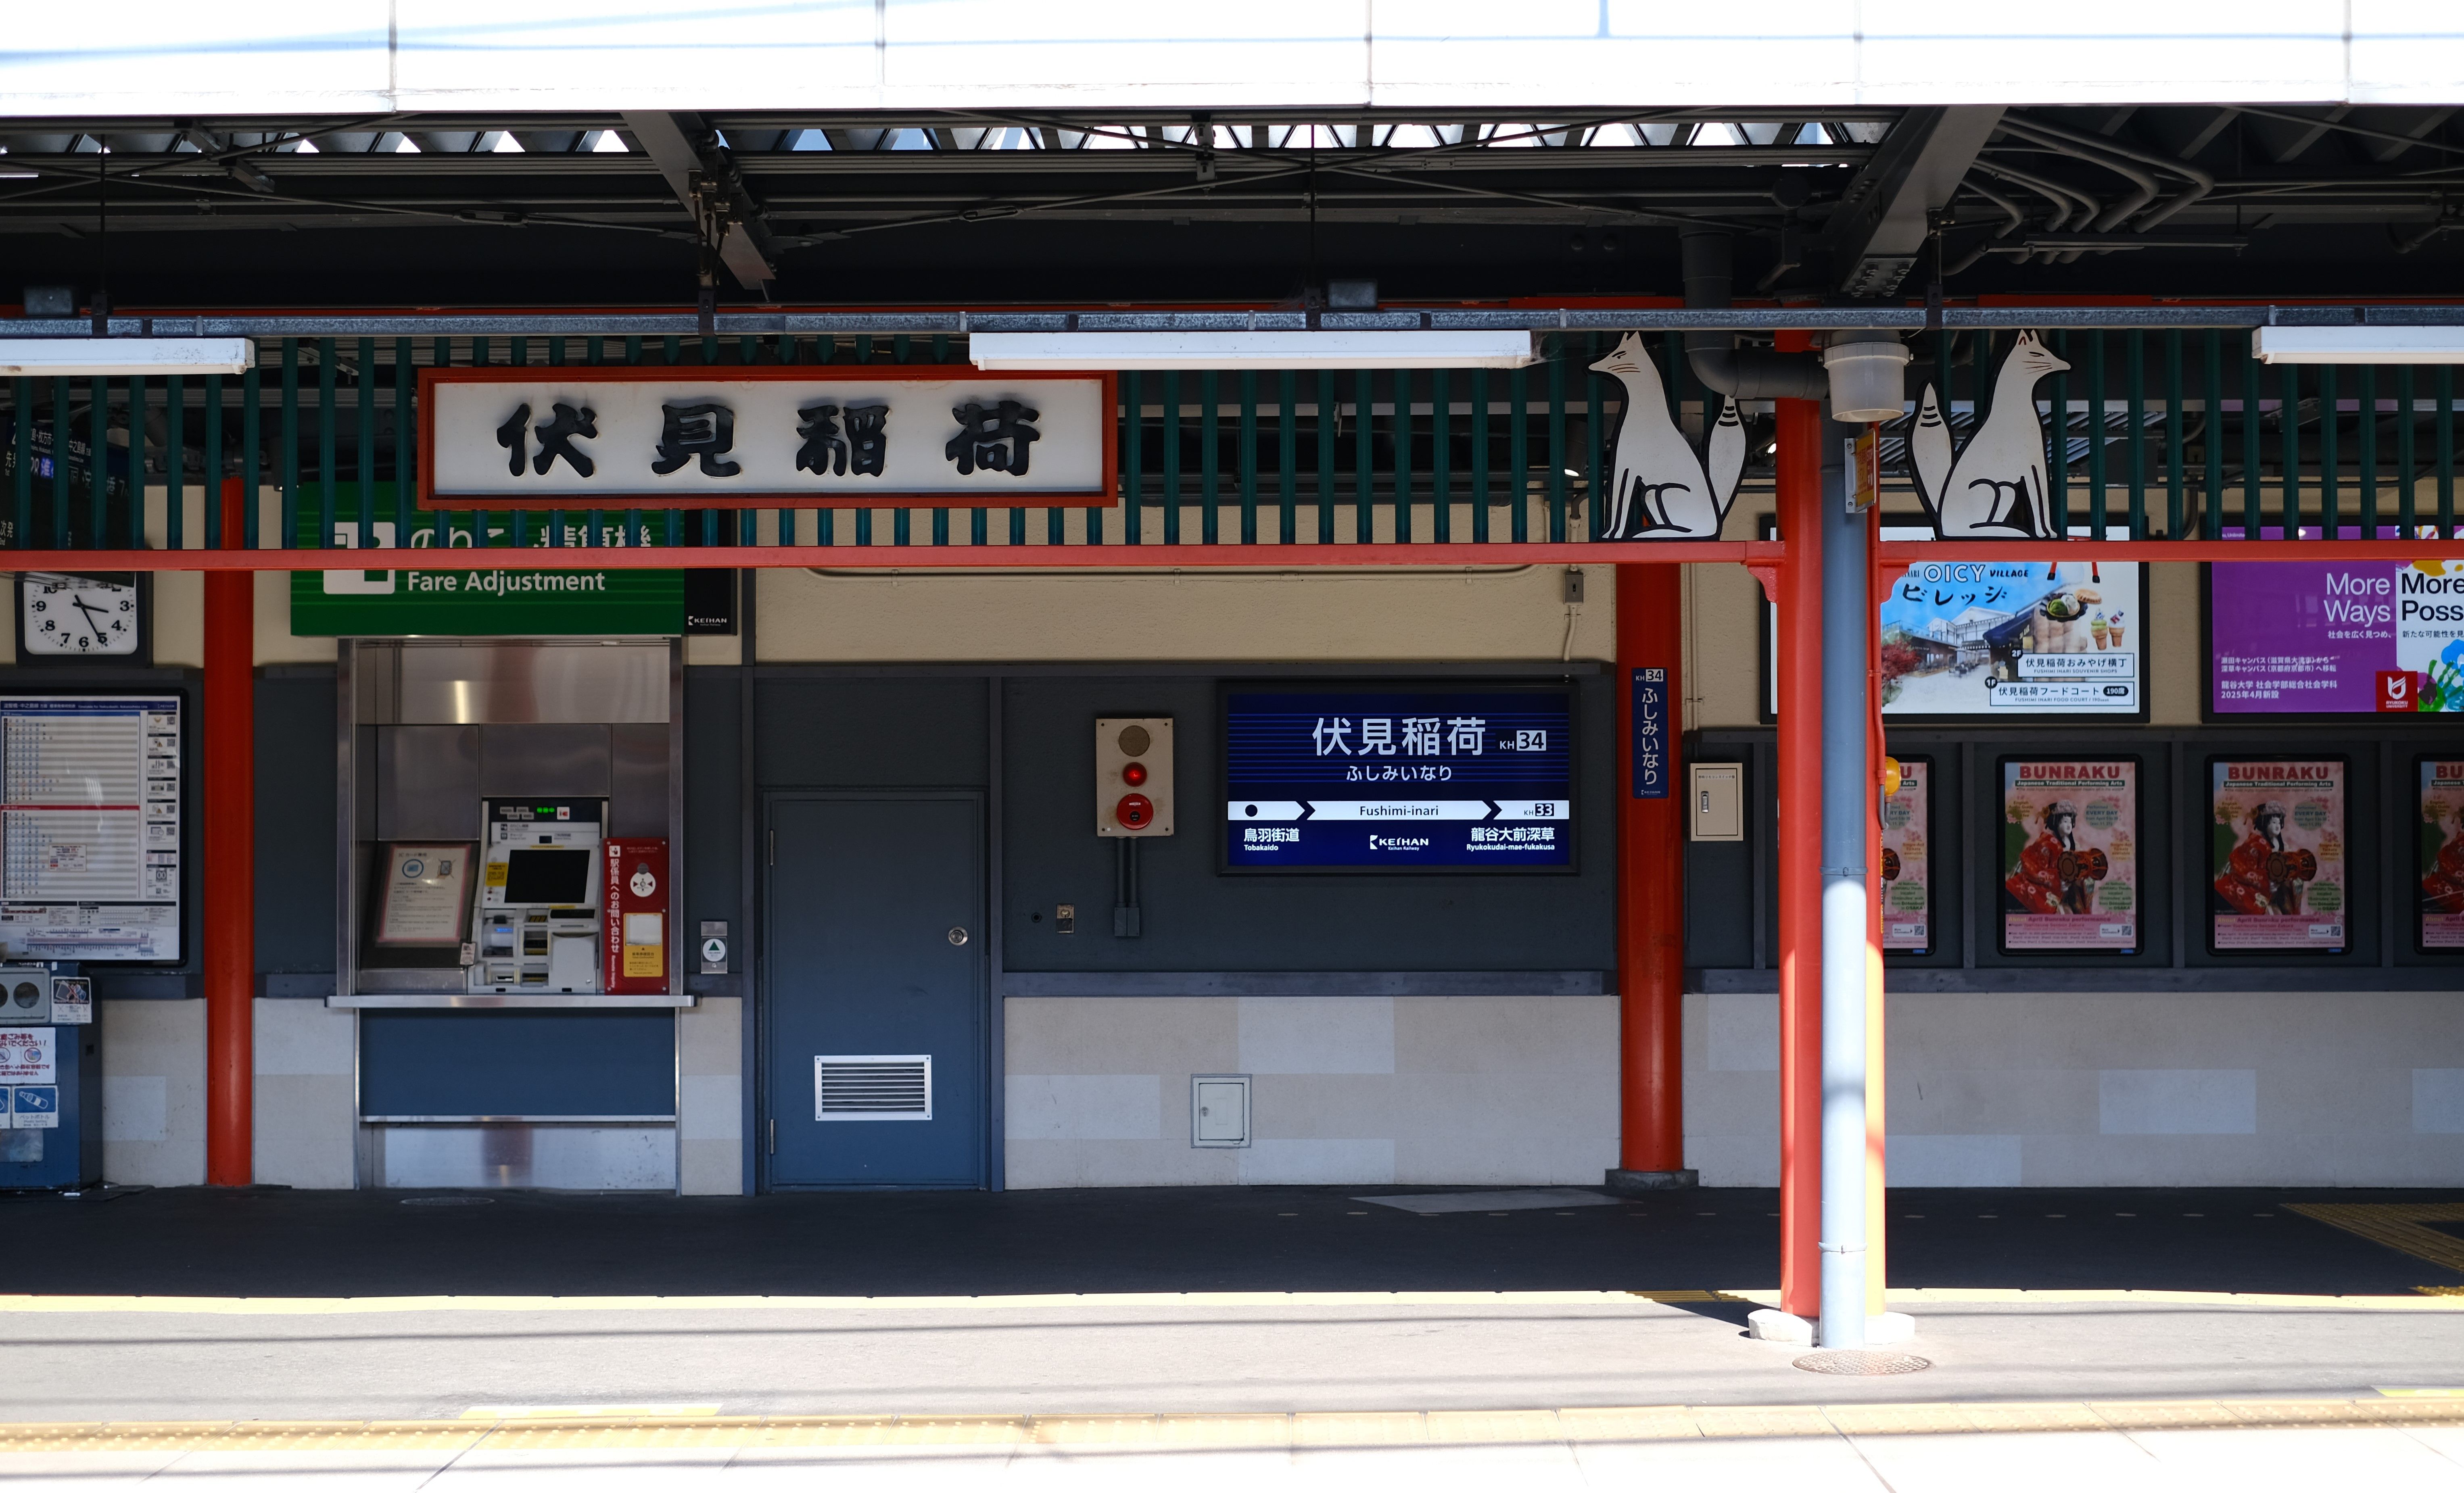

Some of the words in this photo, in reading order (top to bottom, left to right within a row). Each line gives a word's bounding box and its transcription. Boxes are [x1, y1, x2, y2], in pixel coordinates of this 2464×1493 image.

[497, 401, 1041, 478] 伏見稲荷
[1924, 564, 1986, 582] OICY
[408, 571, 457, 591] Fare
[465, 570, 605, 596] Adjustment
[2327, 573, 2390, 595] More
[2402, 573, 2464, 594] More
[1903, 584, 2007, 605] ビレッジ
[36, 601, 46, 611] 9
[119, 601, 130, 611] 3
[2402, 600, 2464, 621] Poss
[2324, 599, 2391, 627] Ways
[45, 620, 55, 631] 8
[111, 620, 122, 631] 4
[61, 633, 71, 643] 7
[2328, 630, 2391, 639] 社会を広く見つめ、
[2403, 630, 2464, 638] 新たな可能性を見
[79, 637, 89, 647] 6
[2026, 658, 2127, 667] 伏見稲荷おみやげ横丁
[1647, 670, 1663, 681] 34
[2221, 680, 2253, 689] 龍谷大学
[2256, 680, 2337, 689] 社会学部総合社会学科
[1998, 687, 2099, 696] 伏見稲荷フードコート
[2221, 690, 2279, 699] 2025年4月新設
[1312, 717, 1485, 756] 伏見稲荷
[1499, 740, 1514, 749] KH
[1519, 734, 1544, 749] 34
[1642, 688, 1658, 785] ふしみいなり
[1346, 765, 1451, 781] ふしみいなり
[2020, 766, 2119, 779] BUNRAKU
[2228, 767, 2328, 780] BUNRAKU
[1360, 805, 1438, 816] Fushimi-inari
[1536, 804, 1553, 816] 33
[1244, 828, 1300, 842] 鳥羽街道
[1471, 827, 1555, 842] 龍谷大前深草
[1379, 837, 1428, 846] KEIHAN
[1466, 843, 1555, 852] Ryukokudai-mae-fukakusa
[610, 858, 620, 953] 駅係員へのお問い合わせ
